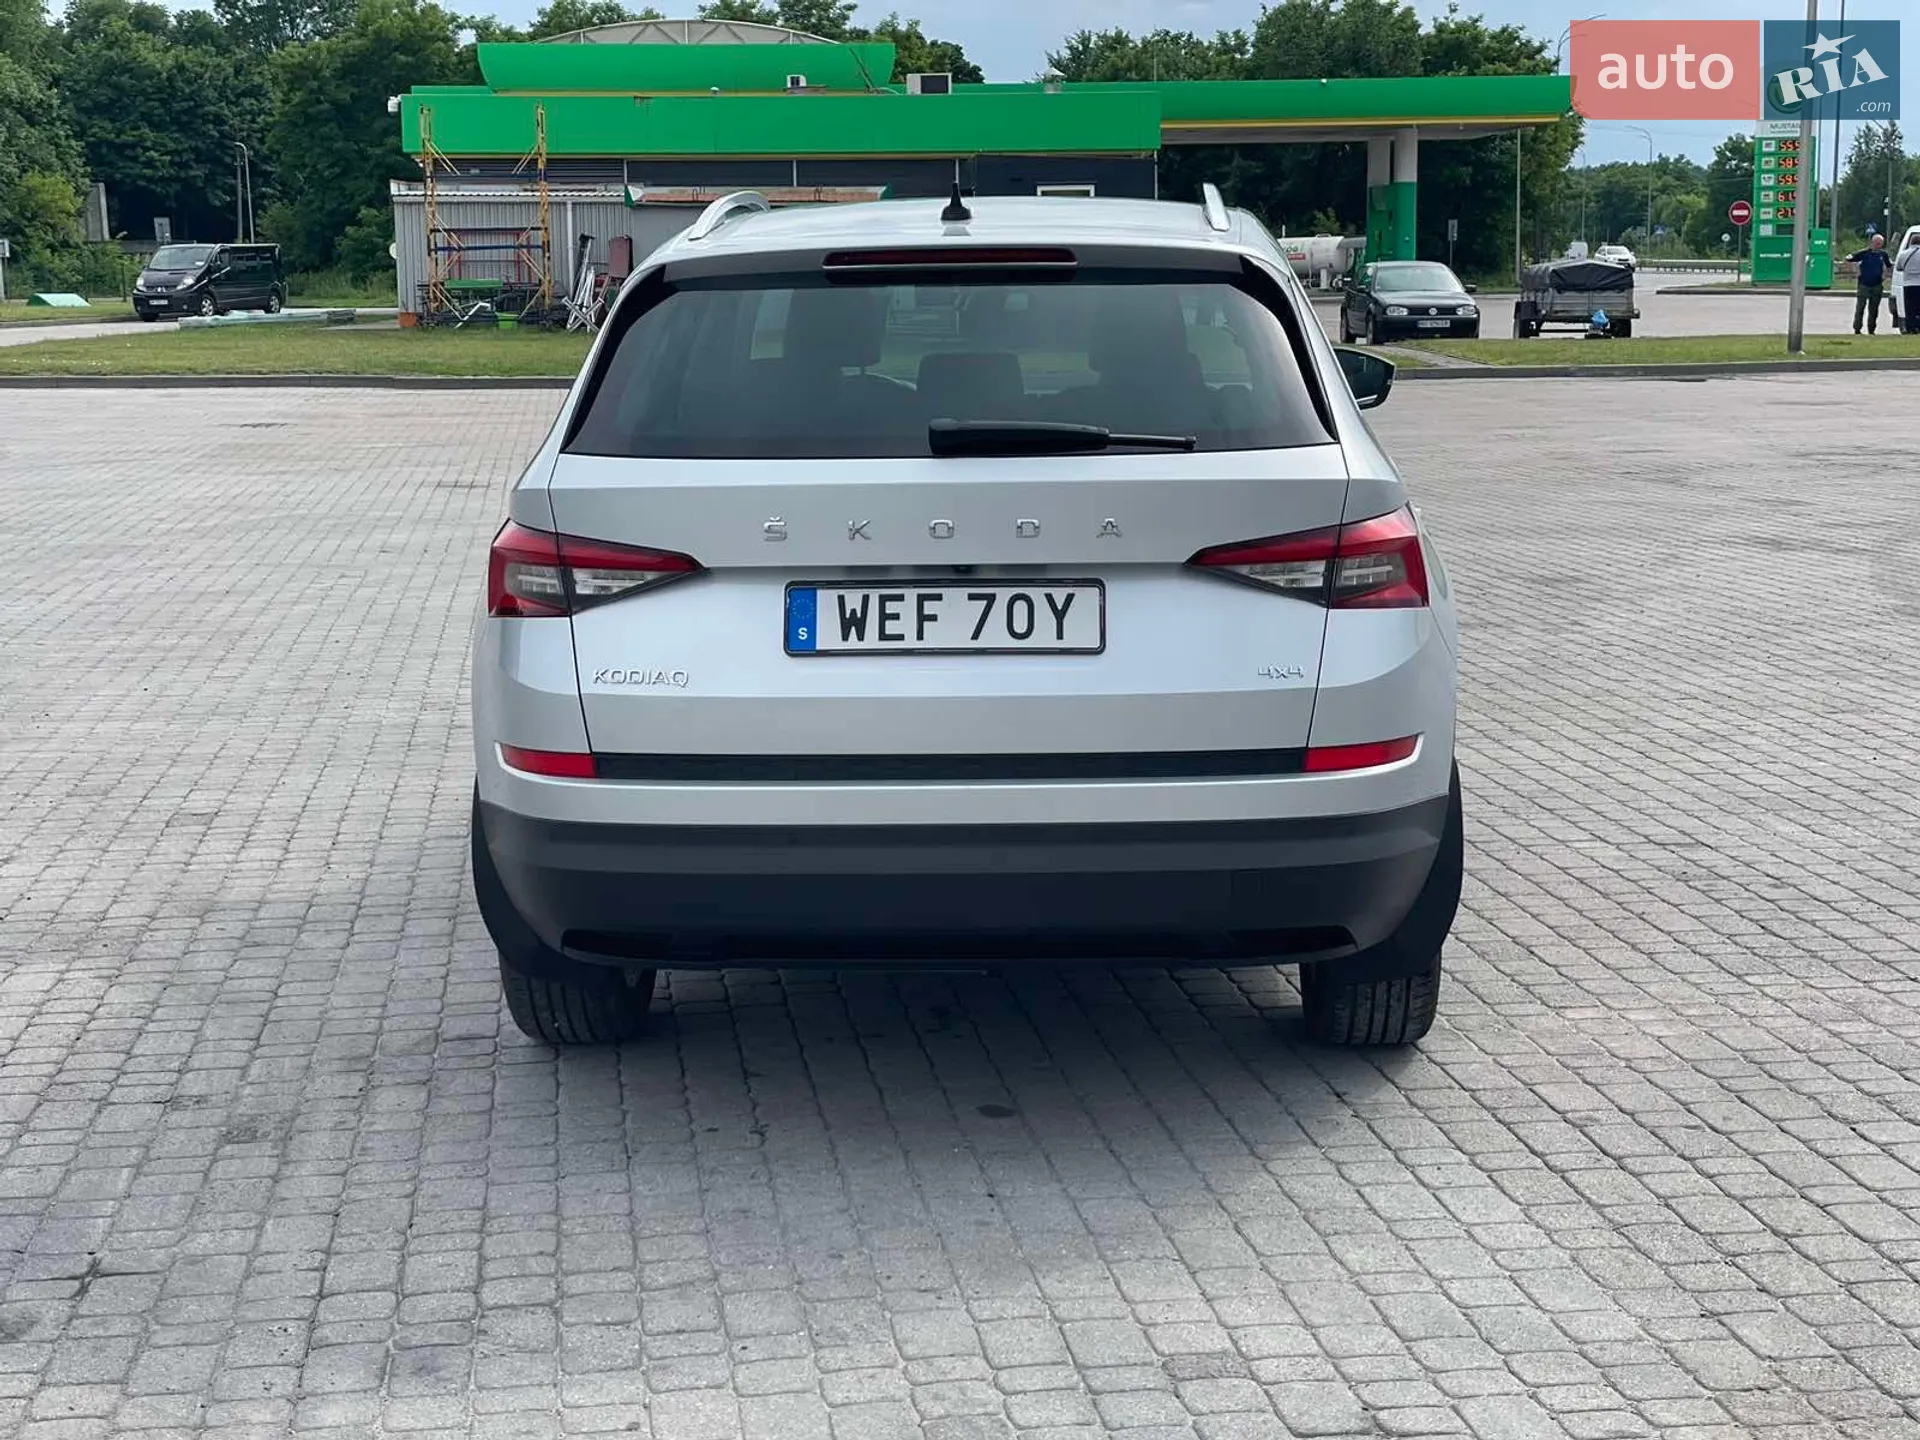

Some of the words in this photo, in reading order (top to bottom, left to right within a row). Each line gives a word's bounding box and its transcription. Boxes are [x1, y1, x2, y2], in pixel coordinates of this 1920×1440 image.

[836, 592, 944, 642] WEF
[967, 592, 1076, 641] 70Y
[798, 627, 808, 641] S
[593, 668, 690, 688] KODIAQ
